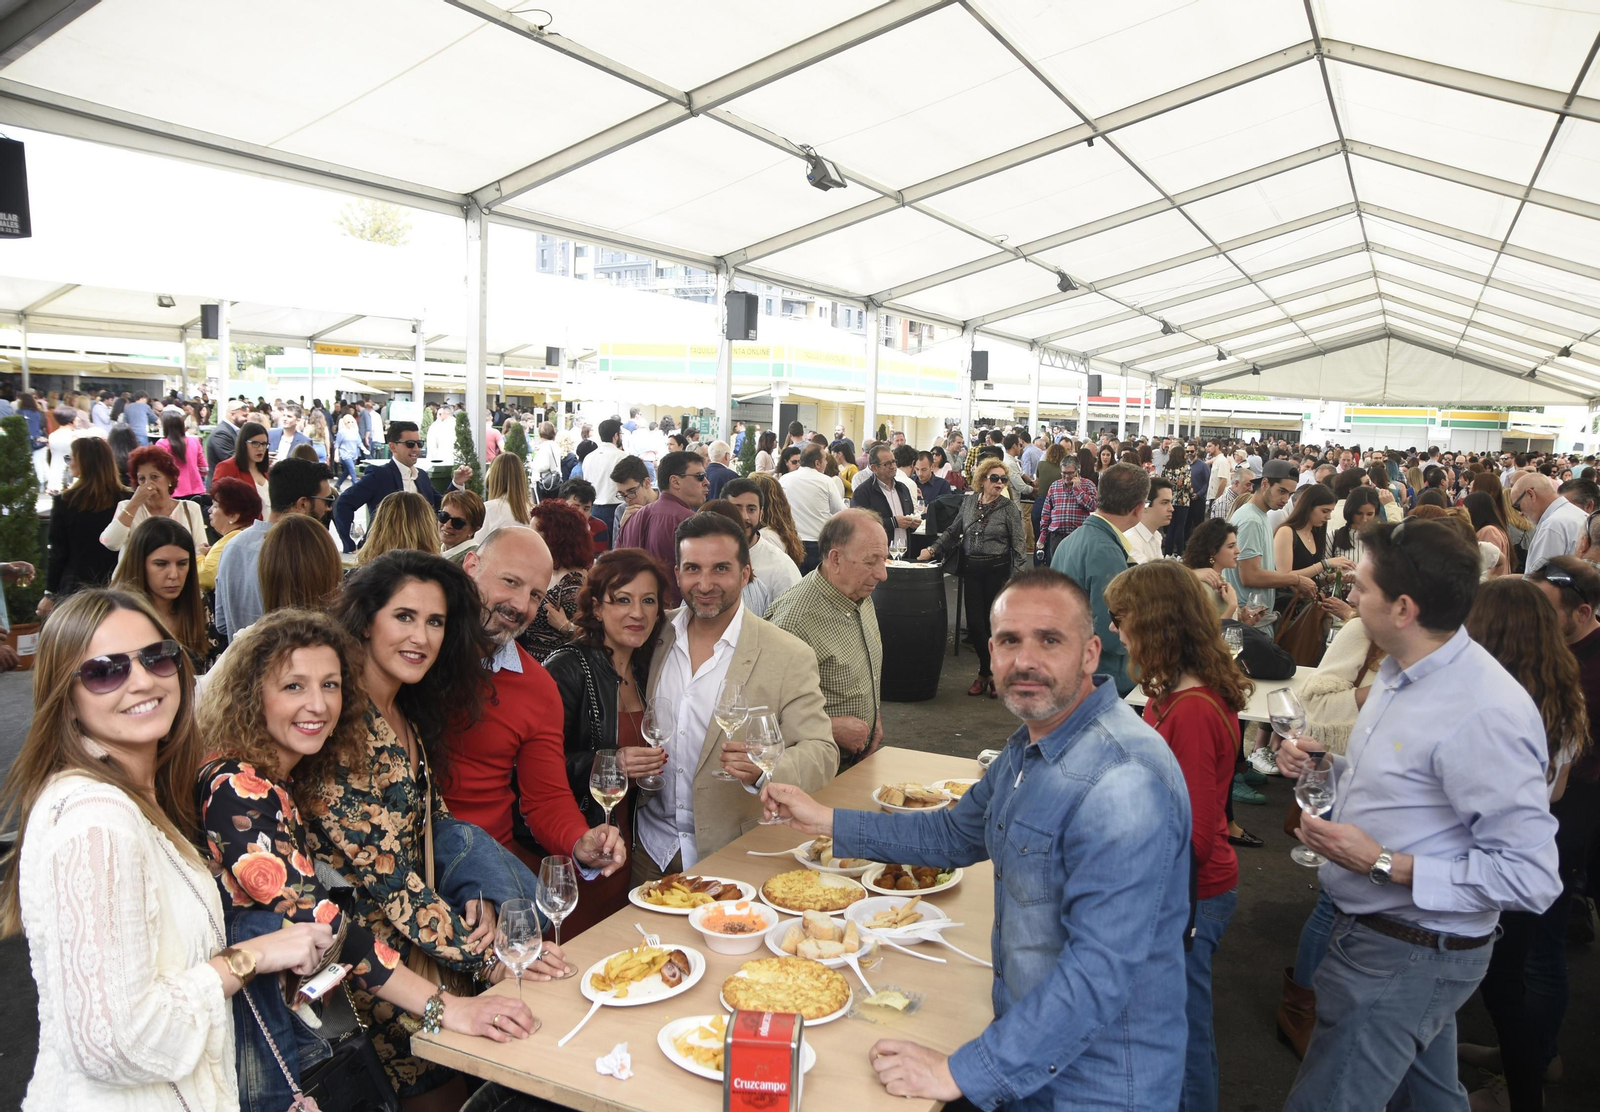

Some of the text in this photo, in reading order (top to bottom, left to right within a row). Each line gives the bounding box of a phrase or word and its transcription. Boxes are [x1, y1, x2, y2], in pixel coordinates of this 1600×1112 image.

[747, 348, 770, 356] ONLINE
[328, 965, 340, 975] 10
[733, 1077, 786, 1092] Cruzcampo
